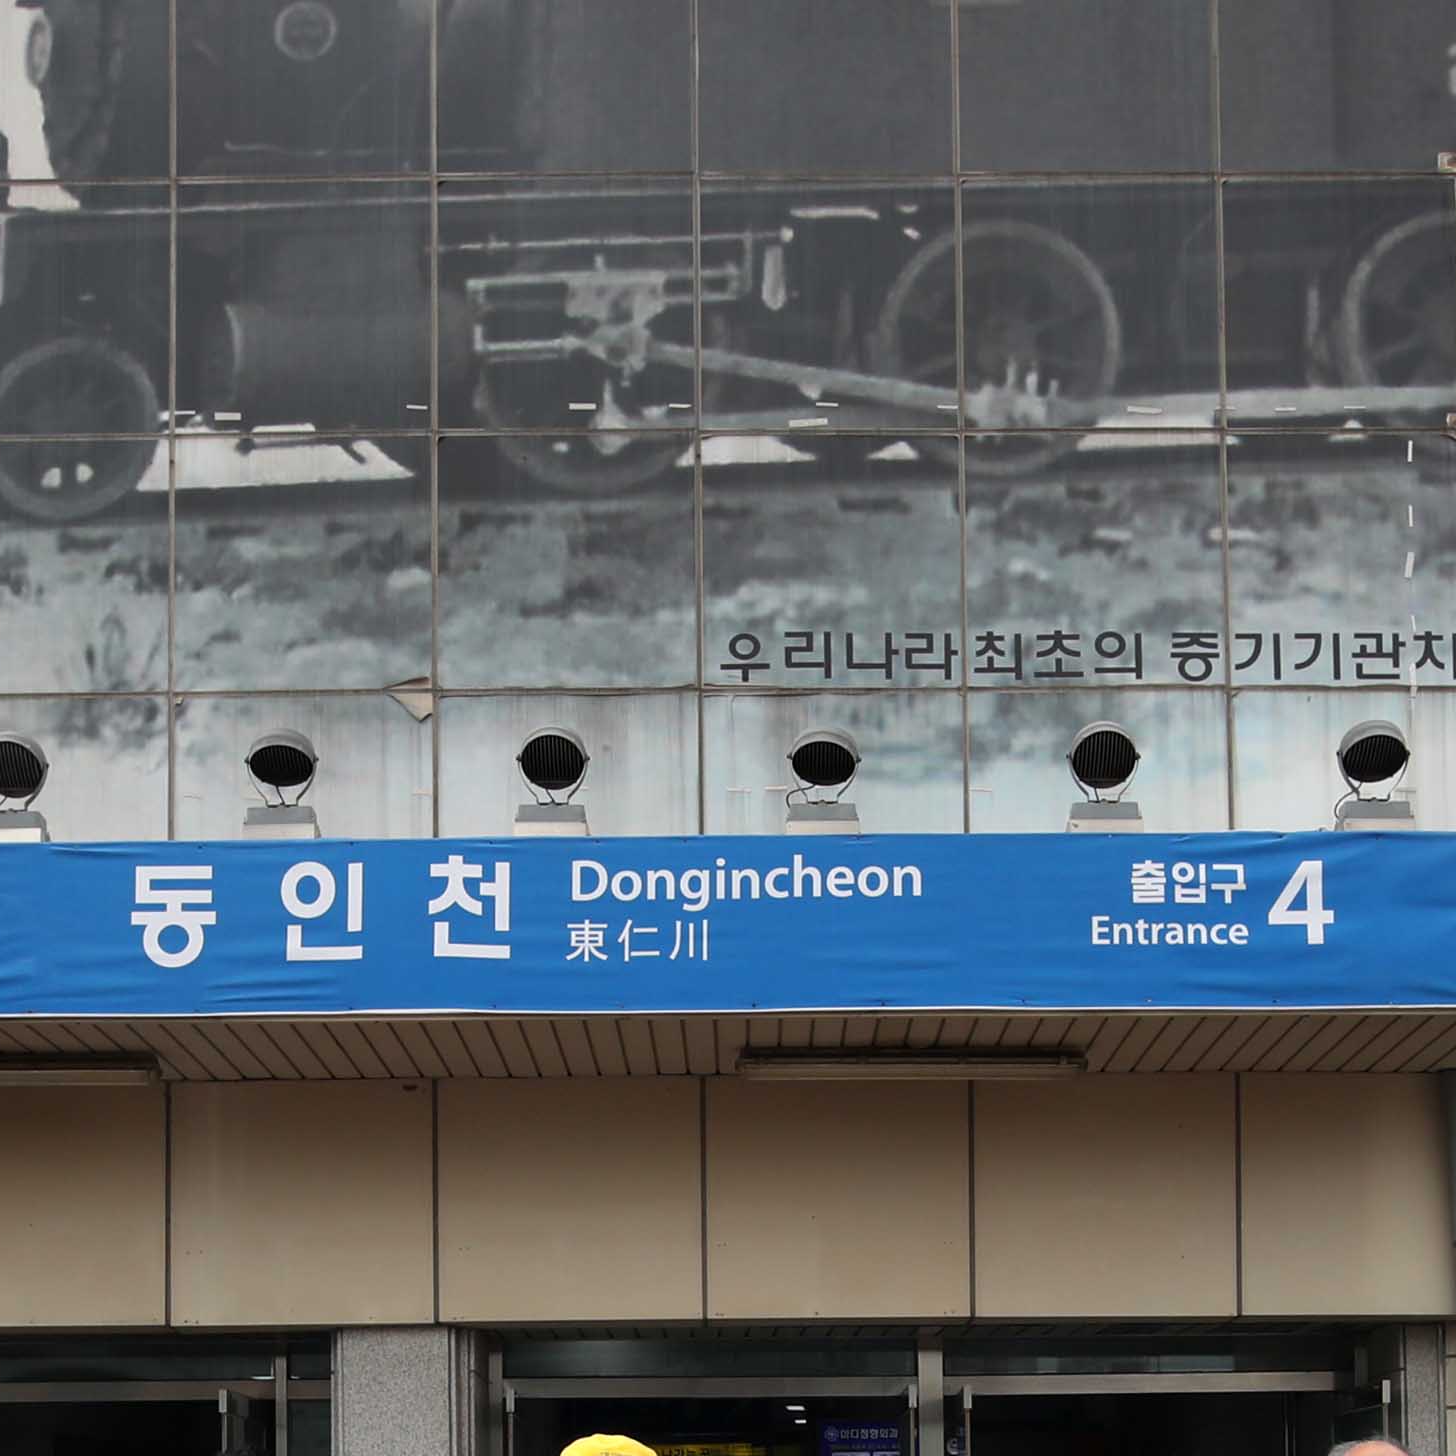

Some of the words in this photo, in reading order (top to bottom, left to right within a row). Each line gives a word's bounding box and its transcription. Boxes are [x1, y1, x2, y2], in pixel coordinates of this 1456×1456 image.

[570, 854, 924, 912] Dongincheon
[1130, 860, 1248, 905] 출입구
[1267, 859, 1335, 947] 4
[130, 854, 512, 968] 동인천
[1090, 914, 1250, 947] Entrance
[564, 918, 711, 962] 東仁川
